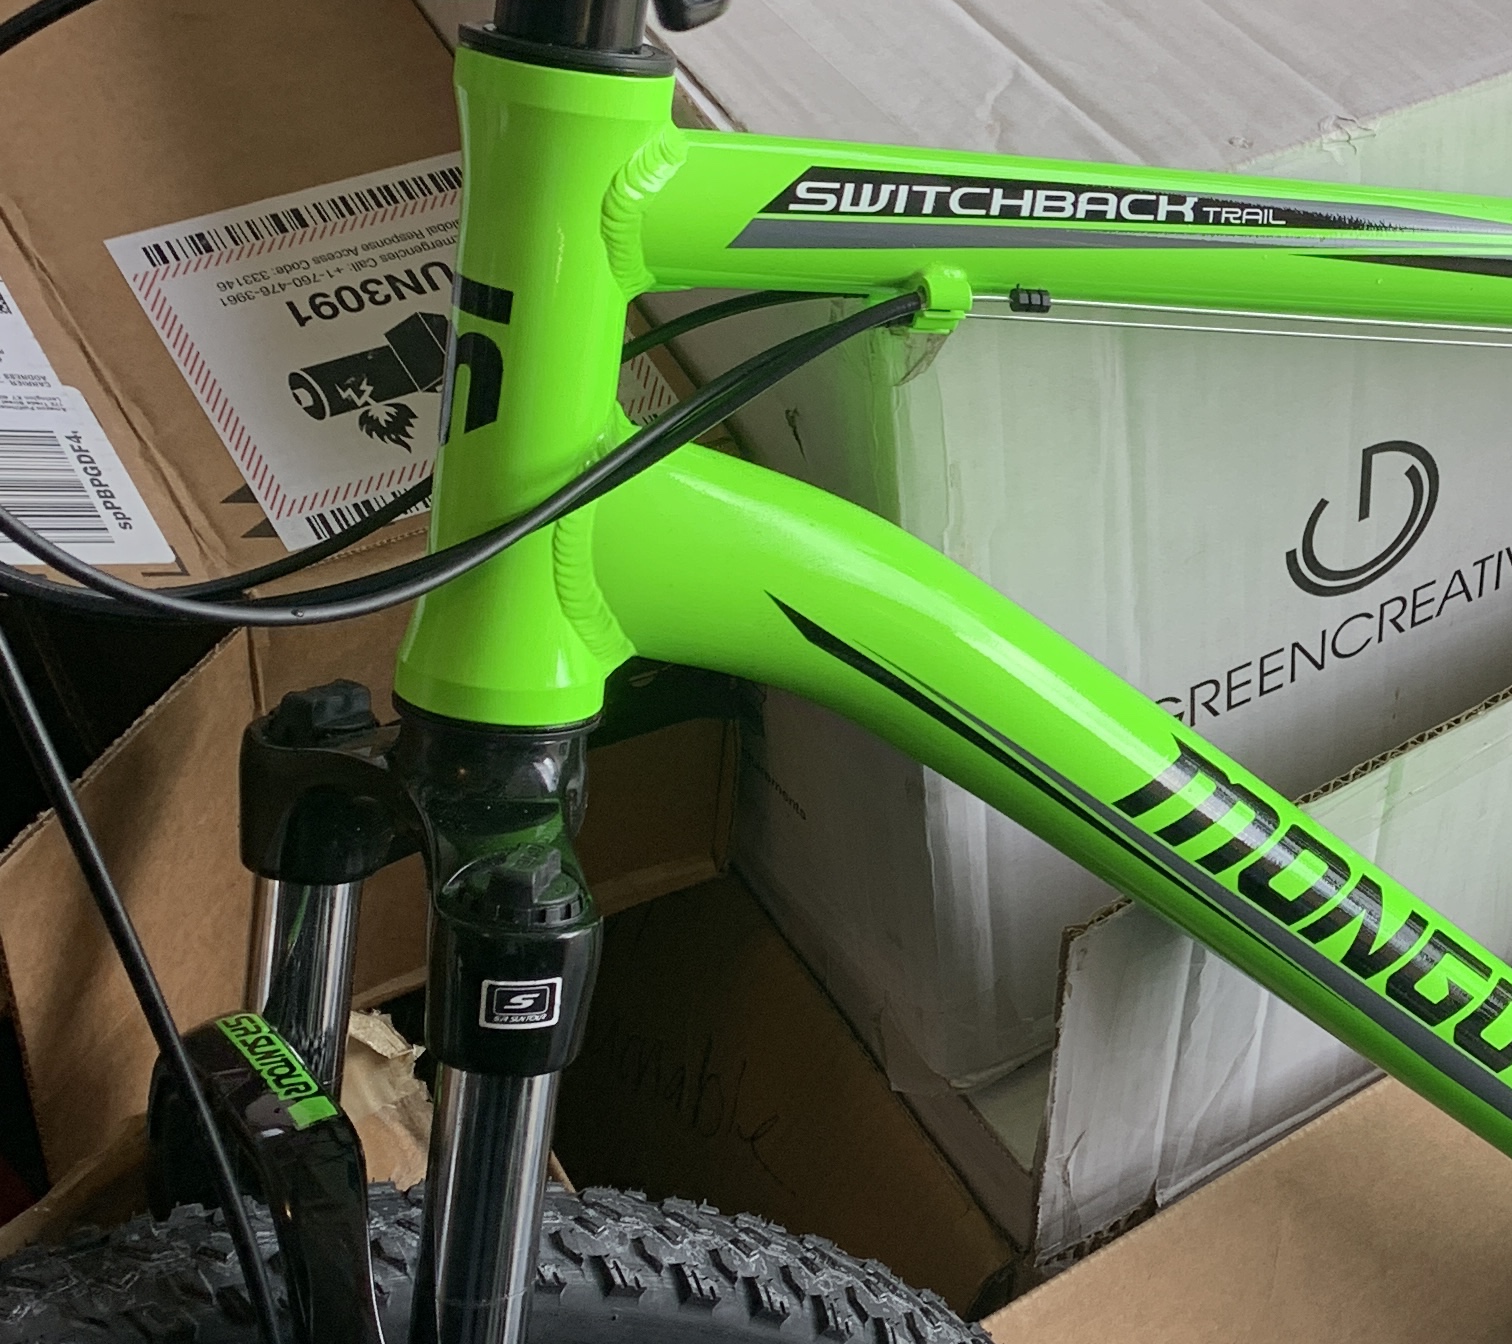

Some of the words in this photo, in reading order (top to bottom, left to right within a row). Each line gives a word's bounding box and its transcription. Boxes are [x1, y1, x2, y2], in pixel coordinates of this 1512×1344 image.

[788, 180, 1199, 223] SWITCHBACK
[1202, 207, 1287, 226] TRAIL
[312, 245, 360, 264] Access
[361, 227, 425, 255] Response
[273, 256, 311, 276] Code:
[348, 254, 377, 272] Call:
[216, 270, 271, 293] 333146
[221, 265, 344, 307] +1-760-476-3961
[286, 260, 455, 327] UN3091
[65, 431, 133, 531] spPBPGDF4
[244, 1034, 311, 1097] SUNTOUR
